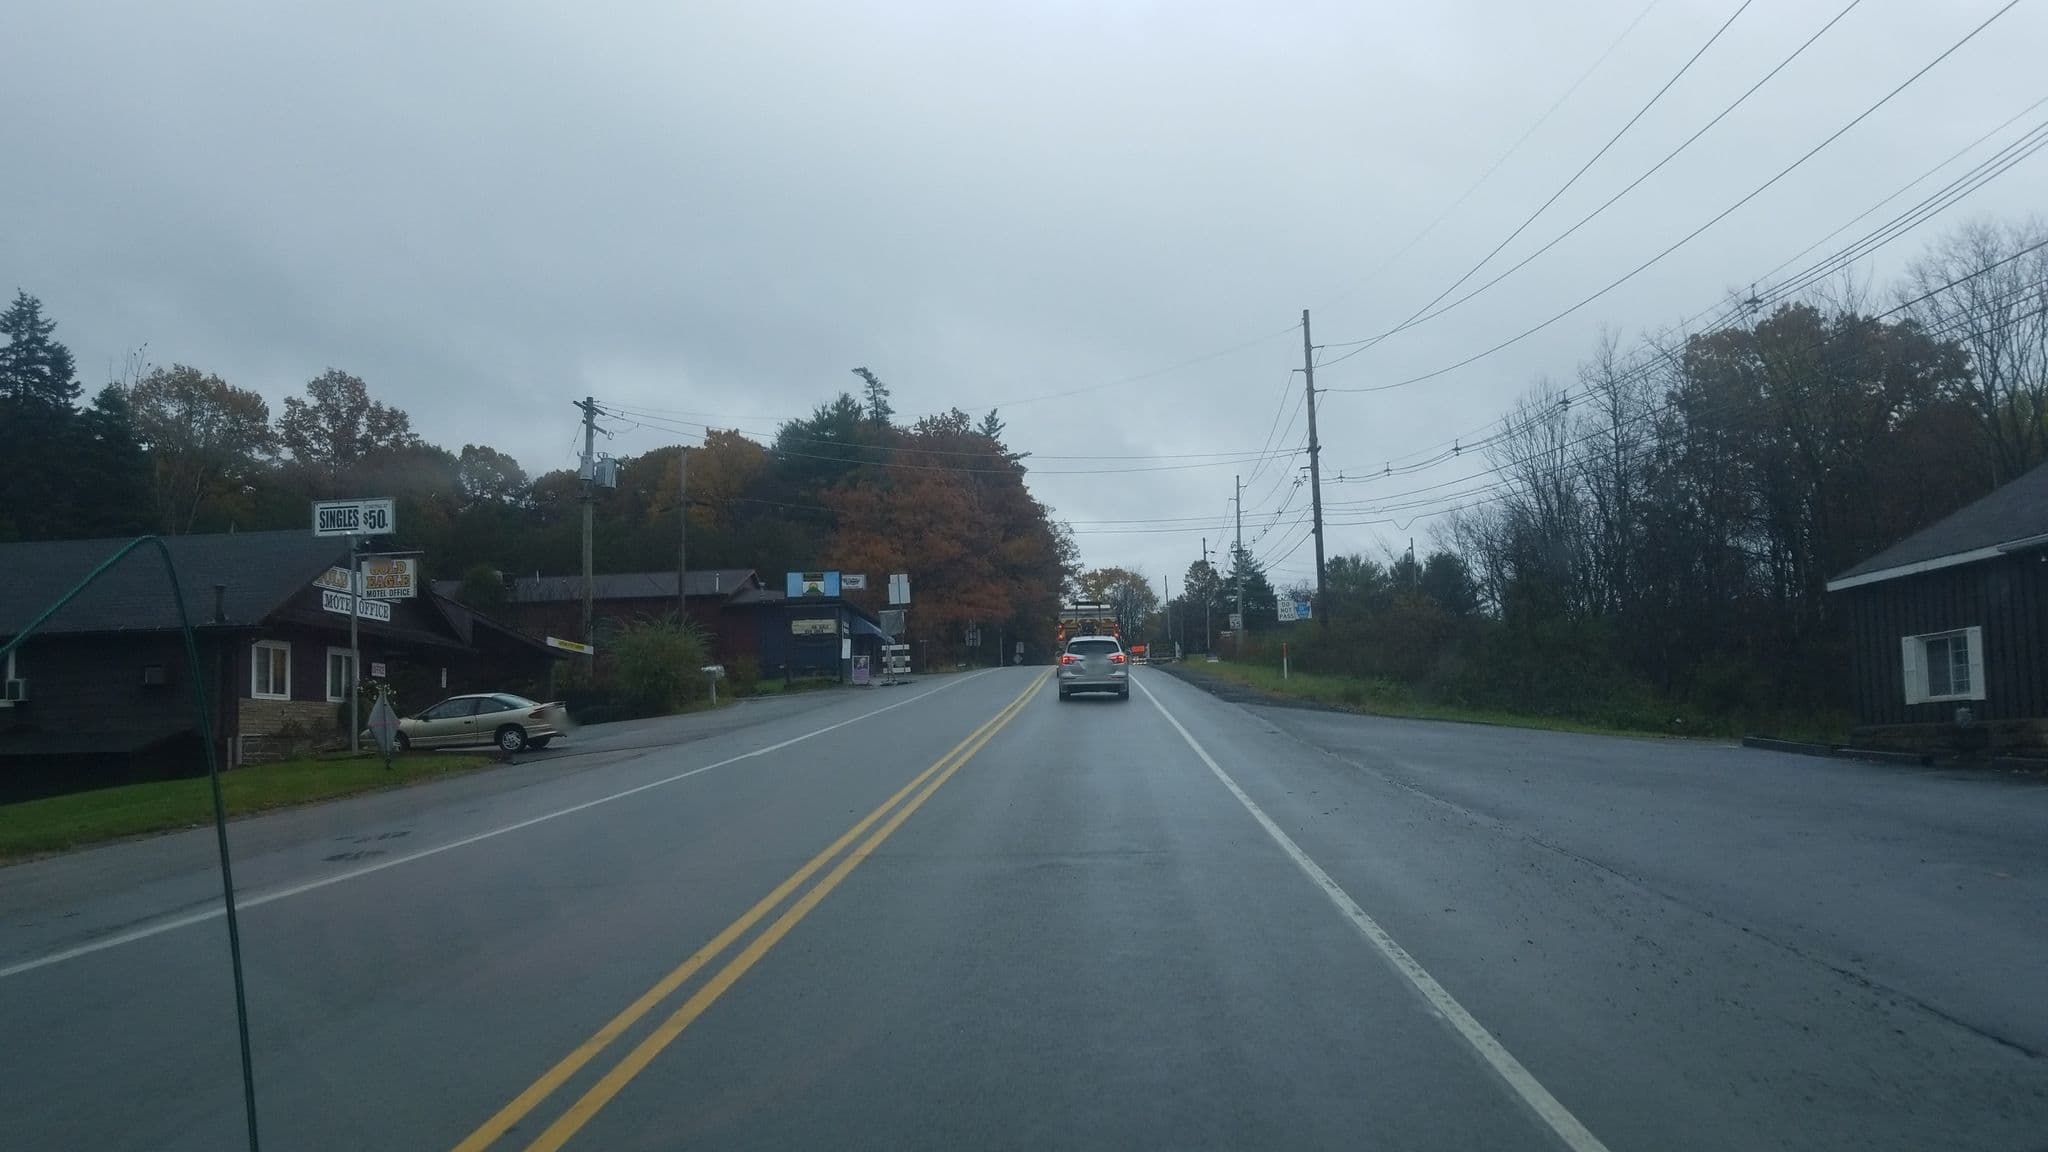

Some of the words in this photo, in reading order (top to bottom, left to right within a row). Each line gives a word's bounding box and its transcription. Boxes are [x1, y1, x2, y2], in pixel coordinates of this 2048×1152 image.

[319, 508, 359, 529] SINGLES
[366, 574, 411, 589] EAGLE
[366, 589, 387, 598] MOTEL
[389, 588, 410, 596] OFFICE
[324, 593, 352, 612] MOTE
[359, 600, 389, 619] OFFICE
